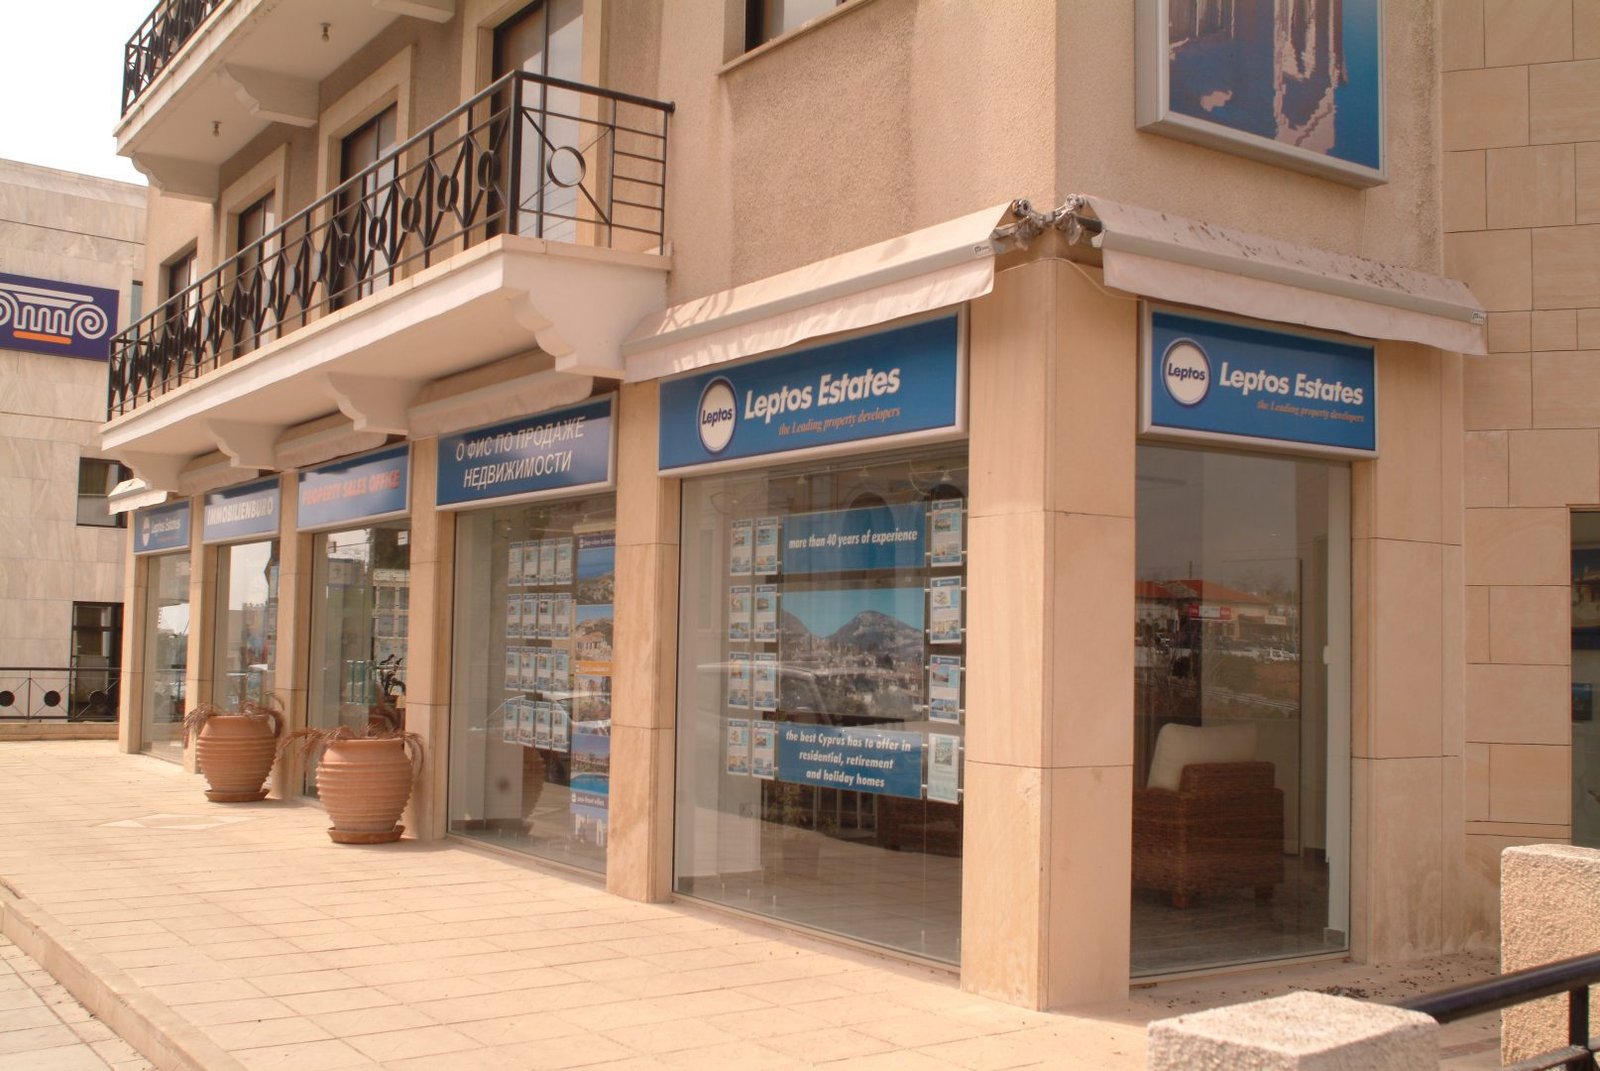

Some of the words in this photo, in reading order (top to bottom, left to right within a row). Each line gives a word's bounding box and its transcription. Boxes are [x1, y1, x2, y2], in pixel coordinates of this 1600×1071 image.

[1168, 362, 1206, 381] Leptos
[1219, 362, 1290, 396] Leptos
[1294, 373, 1364, 405] Estates
[744, 385, 813, 424] Leptos
[818, 367, 901, 407] Estates
[702, 407, 733, 427] Leptos
[823, 414, 857, 431] property
[858, 406, 901, 422] developers
[467, 436, 493, 460] ФИС
[495, 432, 513, 453] ПО
[515, 416, 586, 450] ПРОДАЖЕ
[463, 450, 573, 491] НЕДВИЖИМОСТИ
[788, 538, 807, 549] more
[808, 533, 826, 548] than
[826, 534, 837, 547] 40
[838, 534, 859, 548] years
[861, 529, 872, 544] of
[871, 527, 918, 546] experience
[786, 730, 799, 741] the
[800, 730, 816, 743] best
[818, 732, 845, 748] Cyprus
[846, 735, 862, 748] has
[864, 737, 874, 749] to
[876, 738, 899, 751] offer
[901, 740, 911, 752] in
[799, 750, 844, 766] residential,
[846, 754, 895, 769] retirement
[806, 769, 822, 780] and
[823, 769, 854, 786] holiday
[856, 773, 885, 788] homes
